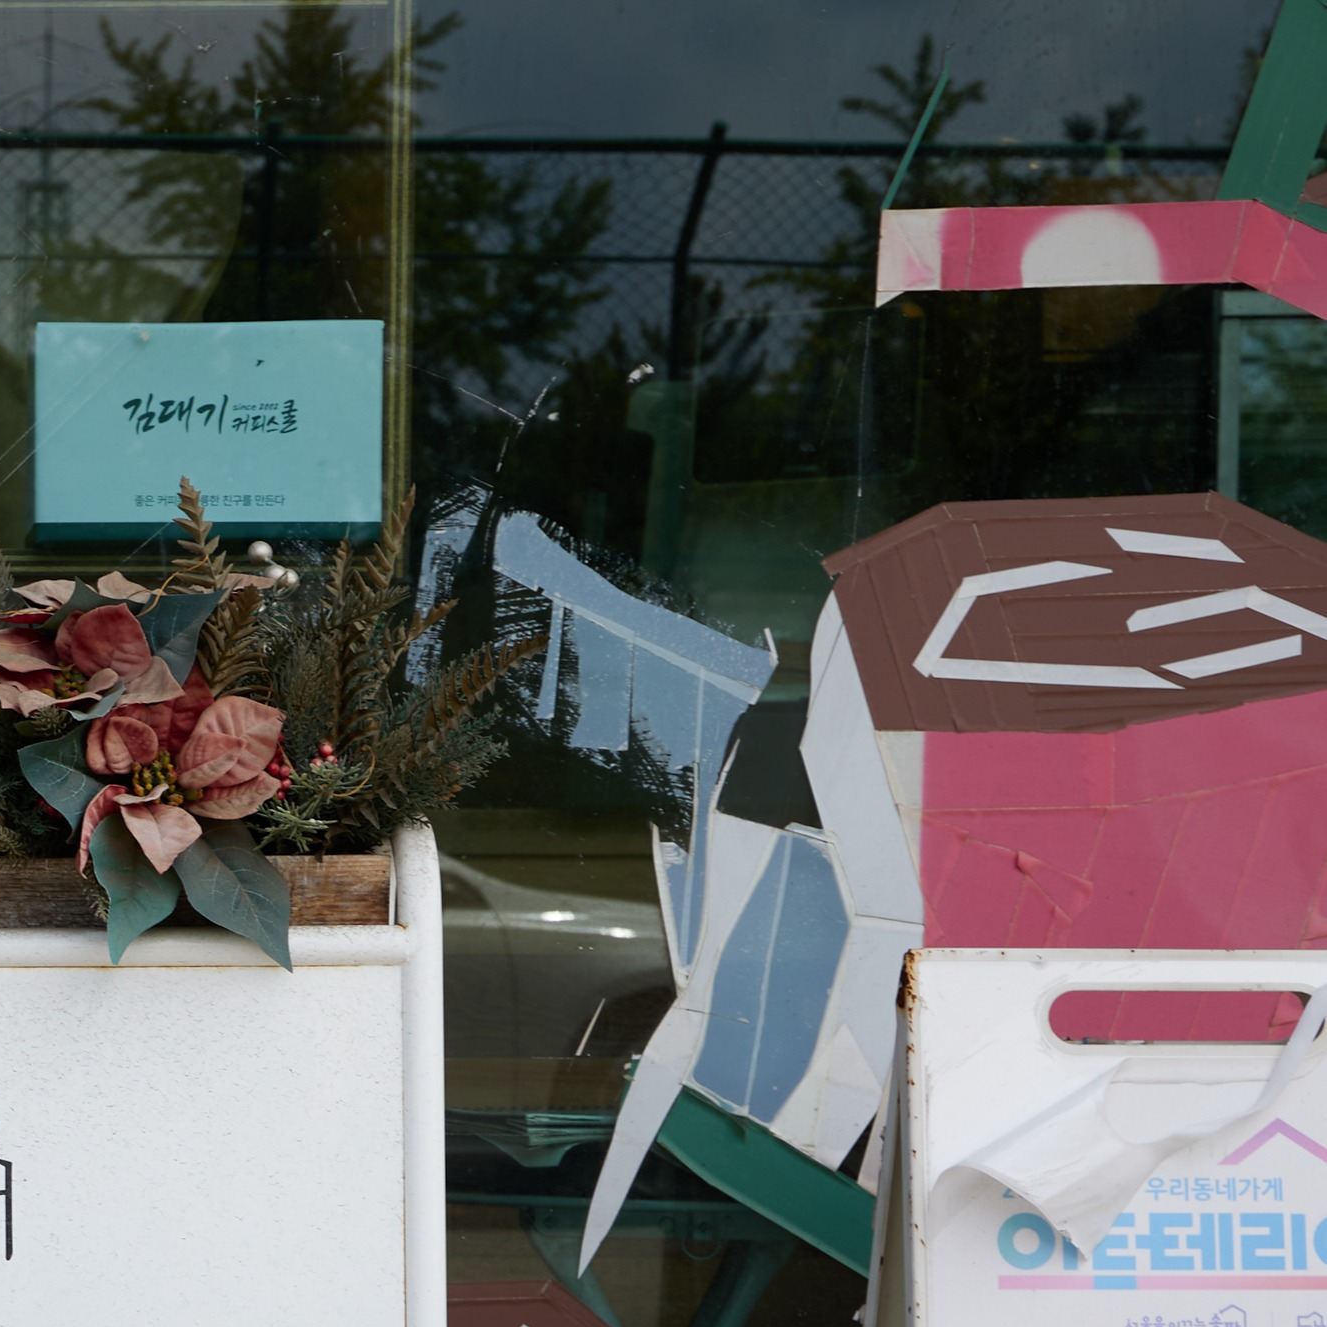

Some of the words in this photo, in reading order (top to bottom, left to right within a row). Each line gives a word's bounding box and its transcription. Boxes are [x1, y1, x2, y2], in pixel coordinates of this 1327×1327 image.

[123, 393, 229, 435] 김대기
[232, 399, 298, 434] 커피스쿨
[254, 494, 285, 507] 만든다
[1144, 1176, 1286, 1203] 우리동네가게
